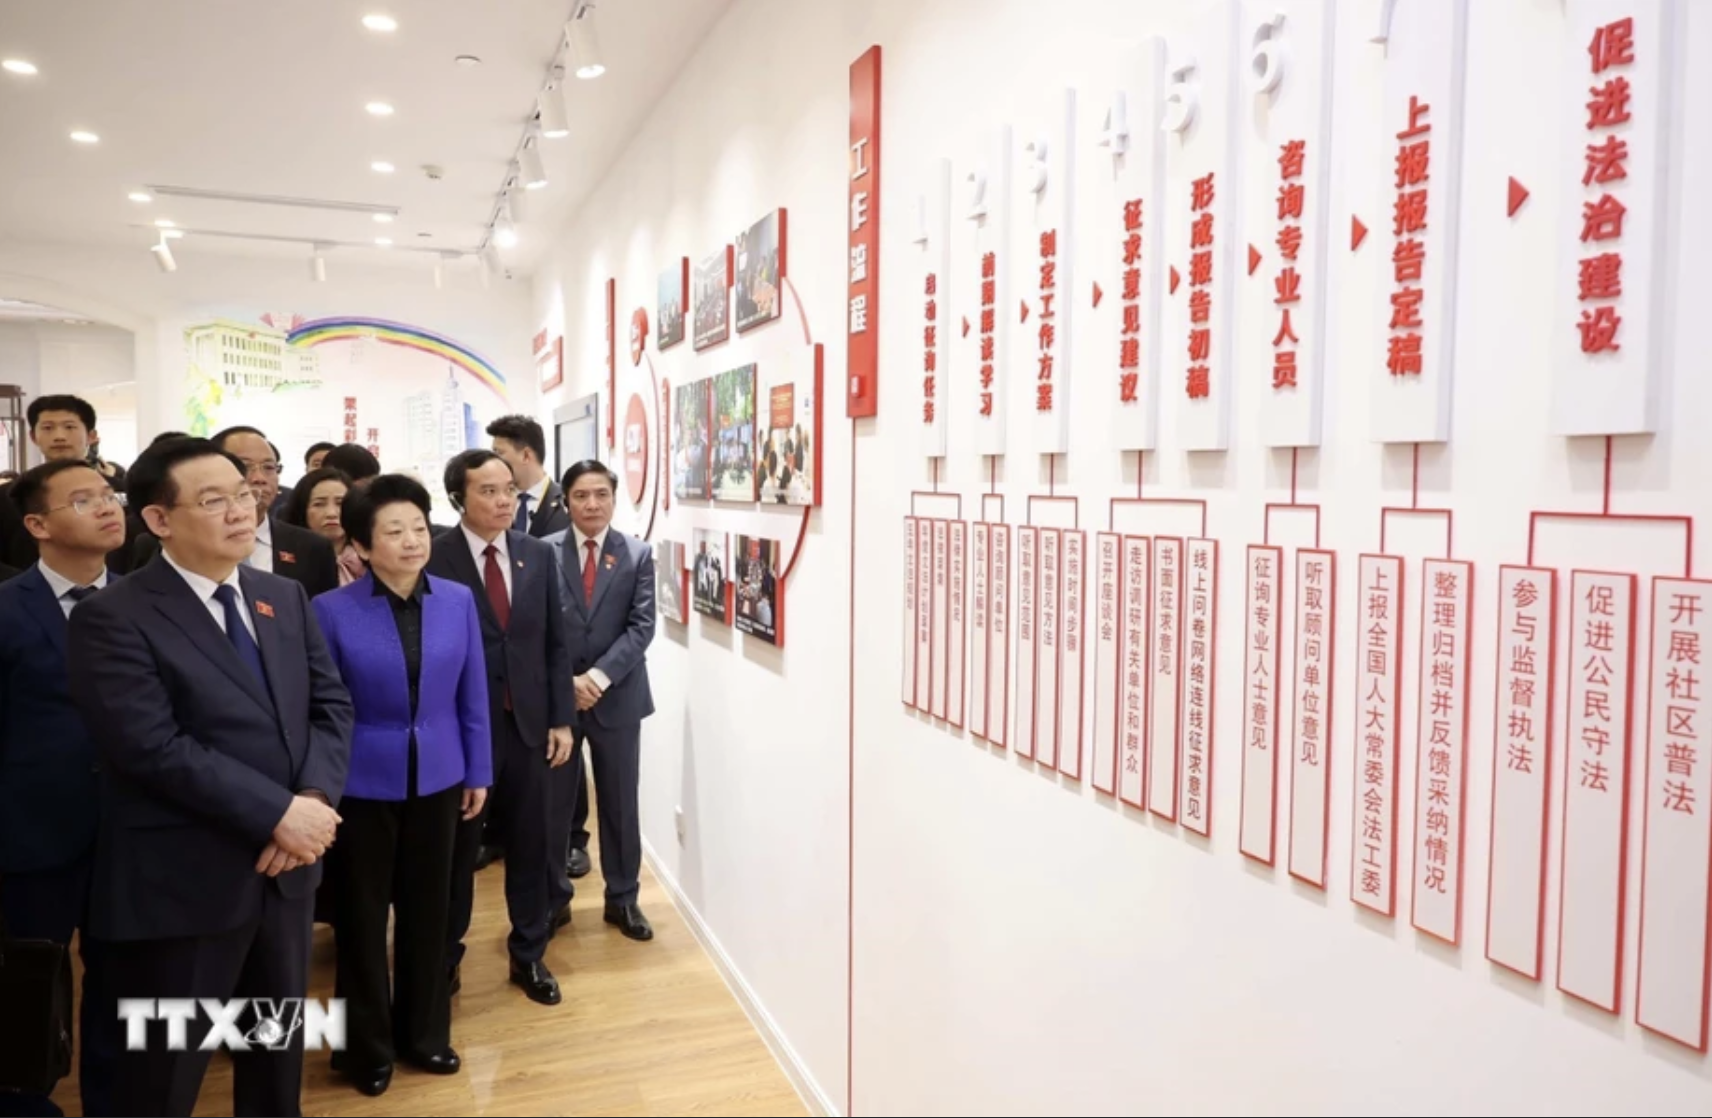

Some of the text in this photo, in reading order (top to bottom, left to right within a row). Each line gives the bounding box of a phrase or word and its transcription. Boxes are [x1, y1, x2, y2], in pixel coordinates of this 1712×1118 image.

[1248, 13, 1287, 97] 6
[1187, 173, 1215, 399] 形成报告初稿
[1273, 140, 1306, 389] 咨询专业人员
[1387, 96, 1431, 376] 上报报告定稿
[1578, 17, 1634, 354] 促进法治建设
[1037, 229, 1056, 411] 制定工作方案
[1120, 199, 1143, 402] 征求意见建议
[1101, 541, 1114, 641] 召开座谈会
[1126, 546, 1144, 774] 走访调研有关单位和群众
[1159, 546, 1174, 675] 书面征求意见
[1187, 549, 1208, 820] 线上问卷网络连线征求意见
[1250, 557, 1272, 750] 征询专业人士意见
[1301, 561, 1323, 766] 听取顾问单位意见
[1508, 578, 1539, 774] 参与监督执法
[1581, 584, 1616, 793] 促进公民守法
[1361, 567, 1389, 896] 上报全国人大常委会法工委
[1424, 571, 1458, 894] 整理归档并反馈采纳情况
[1663, 593, 1704, 815] 开展社区普法
